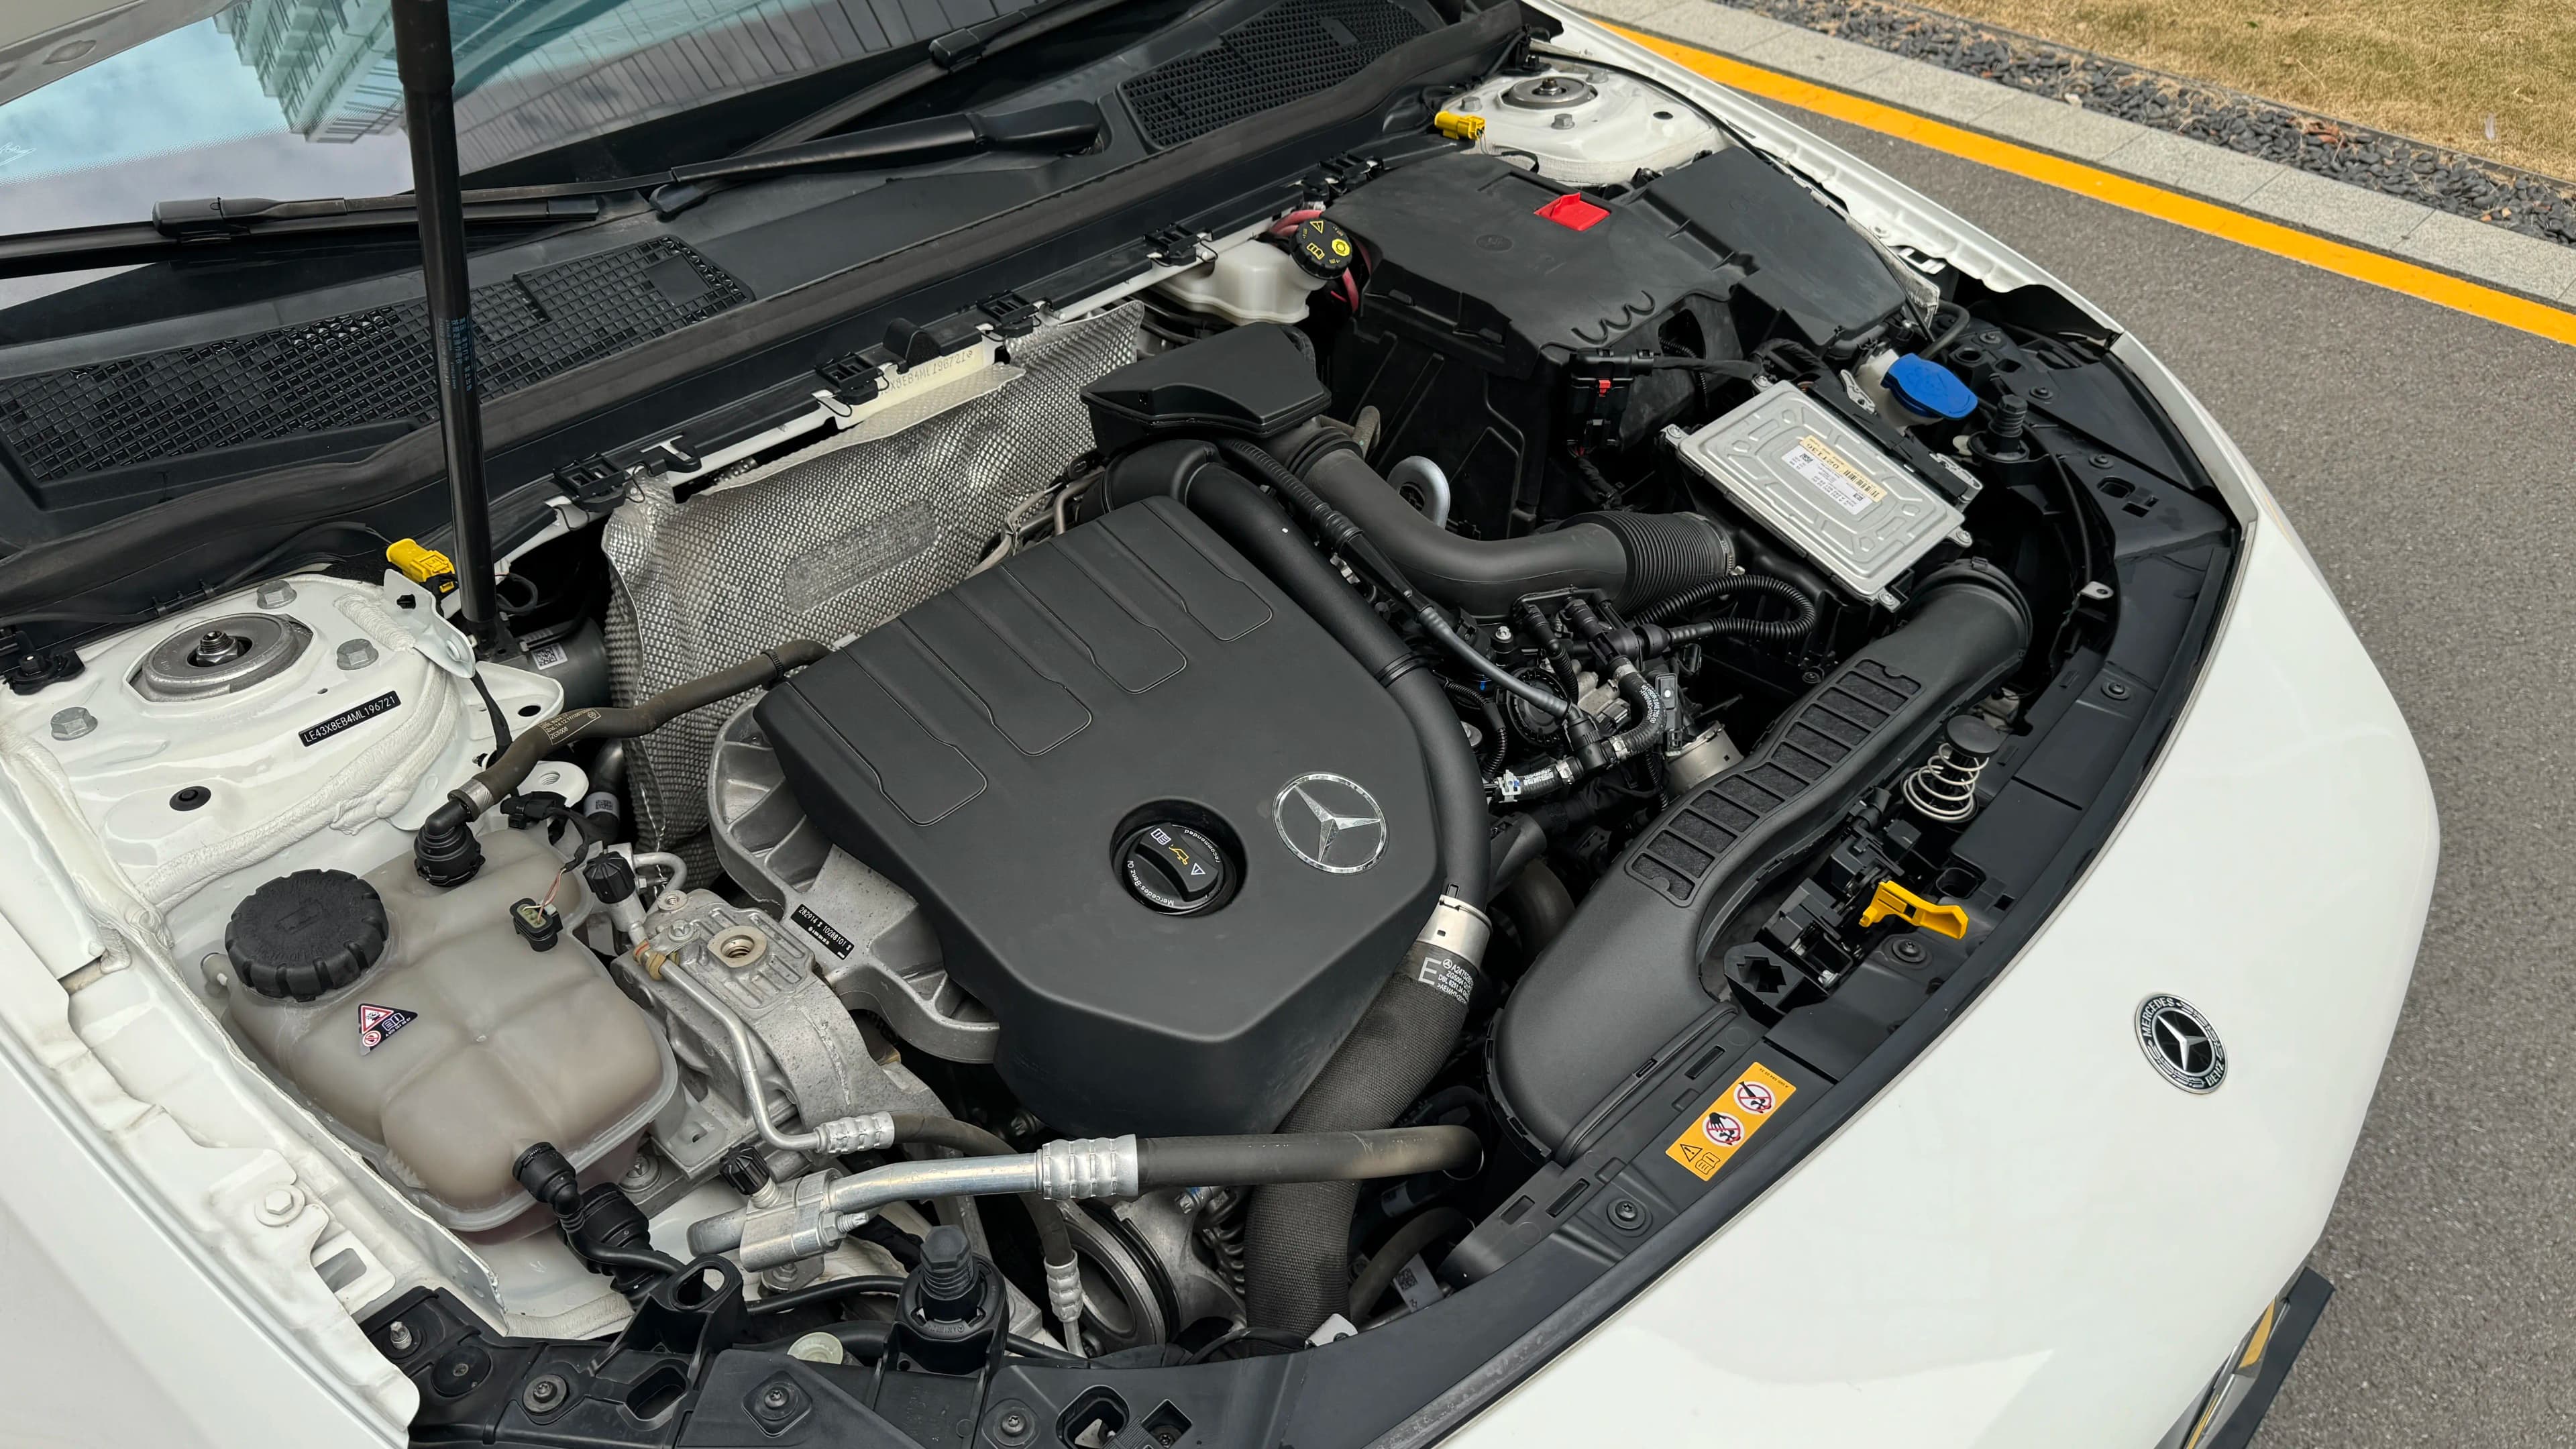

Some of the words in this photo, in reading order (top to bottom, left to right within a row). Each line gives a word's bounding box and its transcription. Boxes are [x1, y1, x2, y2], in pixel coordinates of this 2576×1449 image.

[304, 696, 396, 743] LE43X8EB4ML196721
[1184, 829, 1221, 863] recommended
[798, 906, 816, 924] 282914
[1417, 957, 1442, 985] E
[2140, 998, 2175, 1037] MERCEDES
[2204, 1063, 2224, 1087] BENZ
